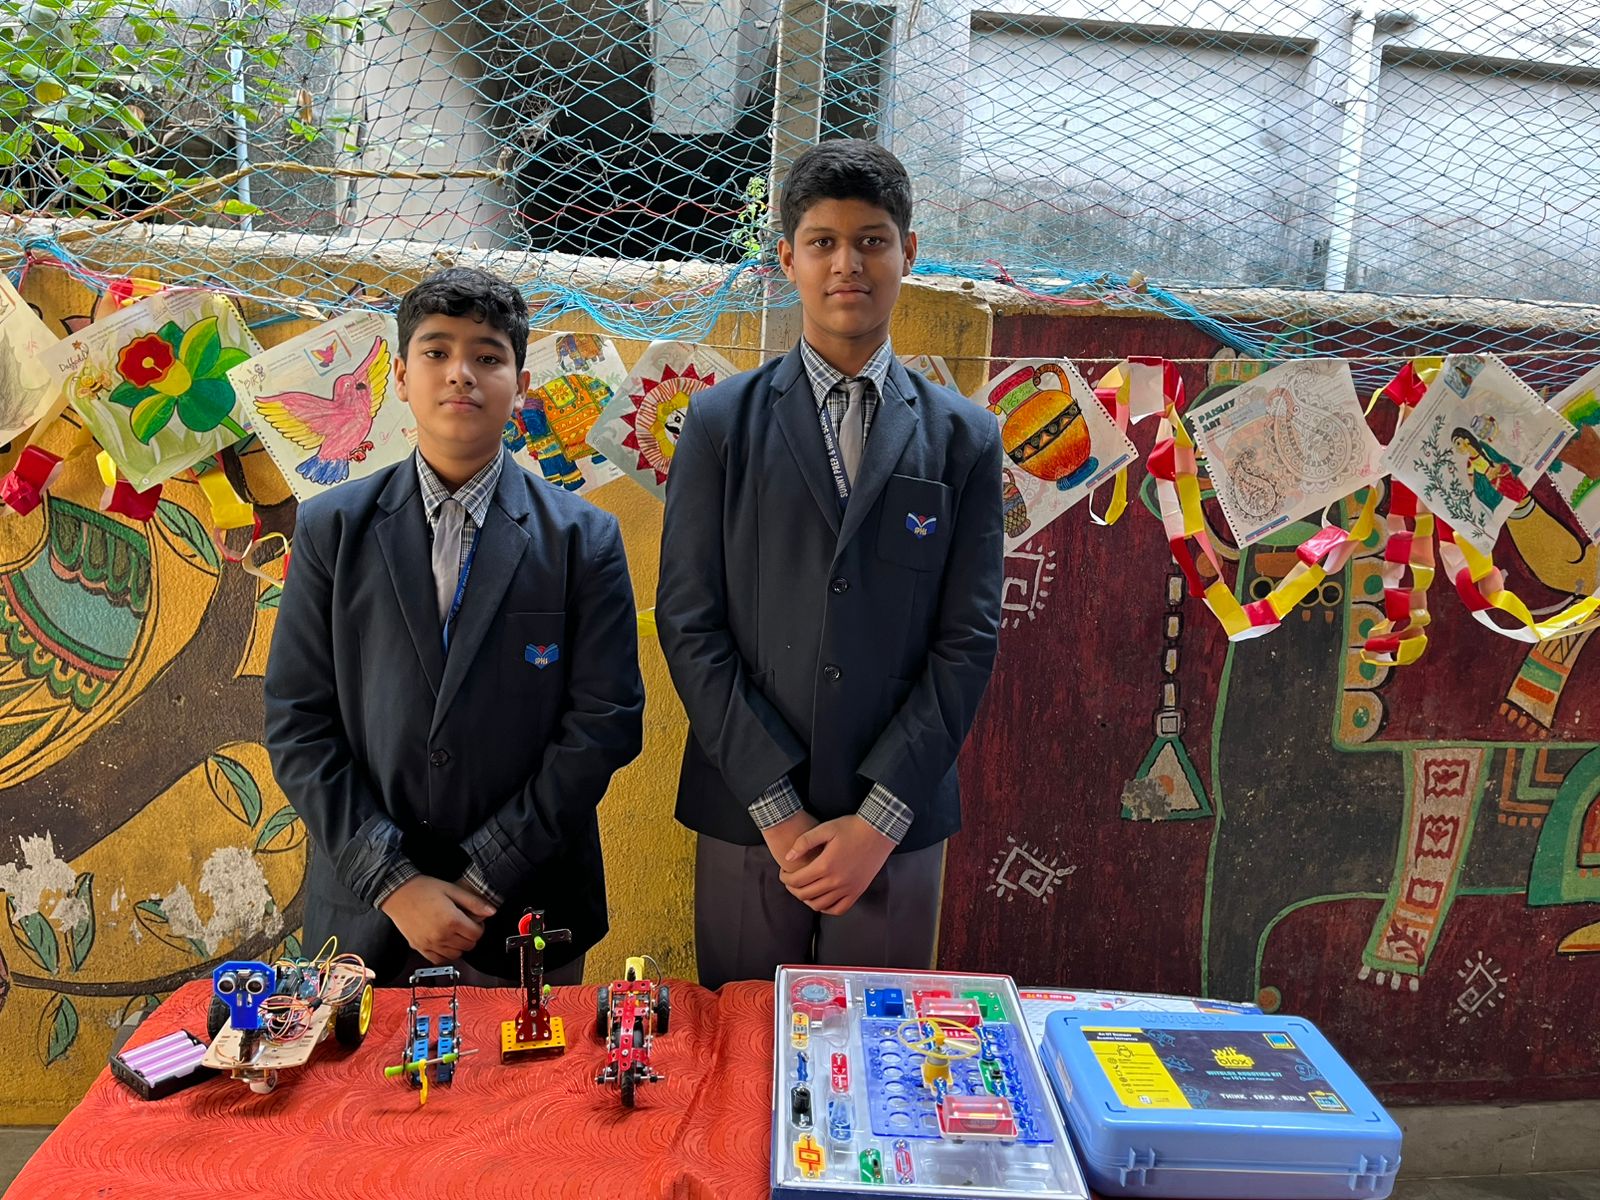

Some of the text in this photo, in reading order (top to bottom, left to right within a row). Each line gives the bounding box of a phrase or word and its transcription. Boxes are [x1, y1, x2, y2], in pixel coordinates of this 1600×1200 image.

[1198, 398, 1235, 423] PAISLEY
[1202, 417, 1221, 433] ART
[835, 475, 848, 498] SUNNY
